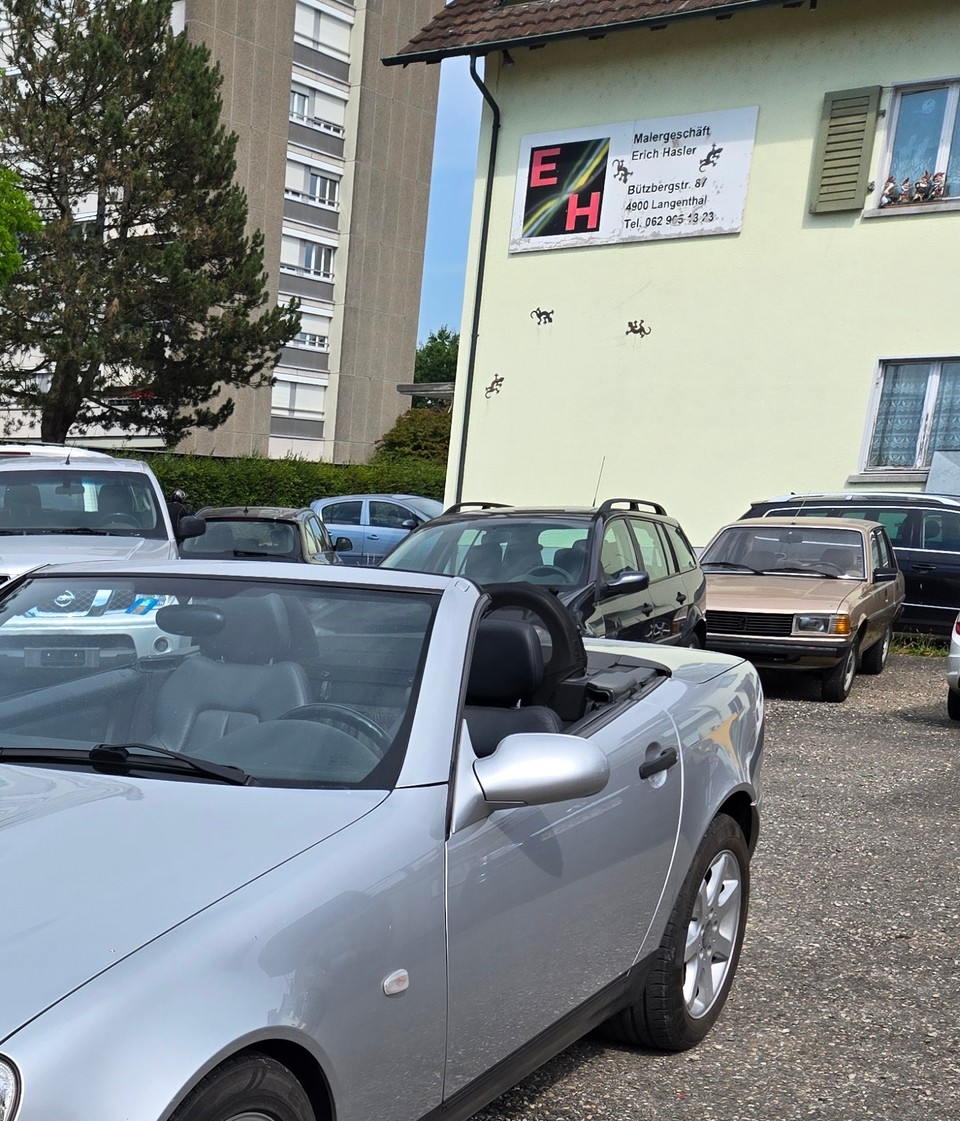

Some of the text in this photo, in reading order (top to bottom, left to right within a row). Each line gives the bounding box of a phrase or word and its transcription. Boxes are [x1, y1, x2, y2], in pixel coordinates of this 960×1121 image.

[633, 125, 711, 144] Malergeschäft
[631, 145, 697, 161] Erich Hasler
[530, 147, 561, 188] E
[627, 181, 692, 195] Bützbergstr.
[565, 191, 601, 231] H
[625, 195, 708, 212] 4900 Langenthal
[624, 218, 642, 229] Tel.
[645, 215, 663, 227] 062
